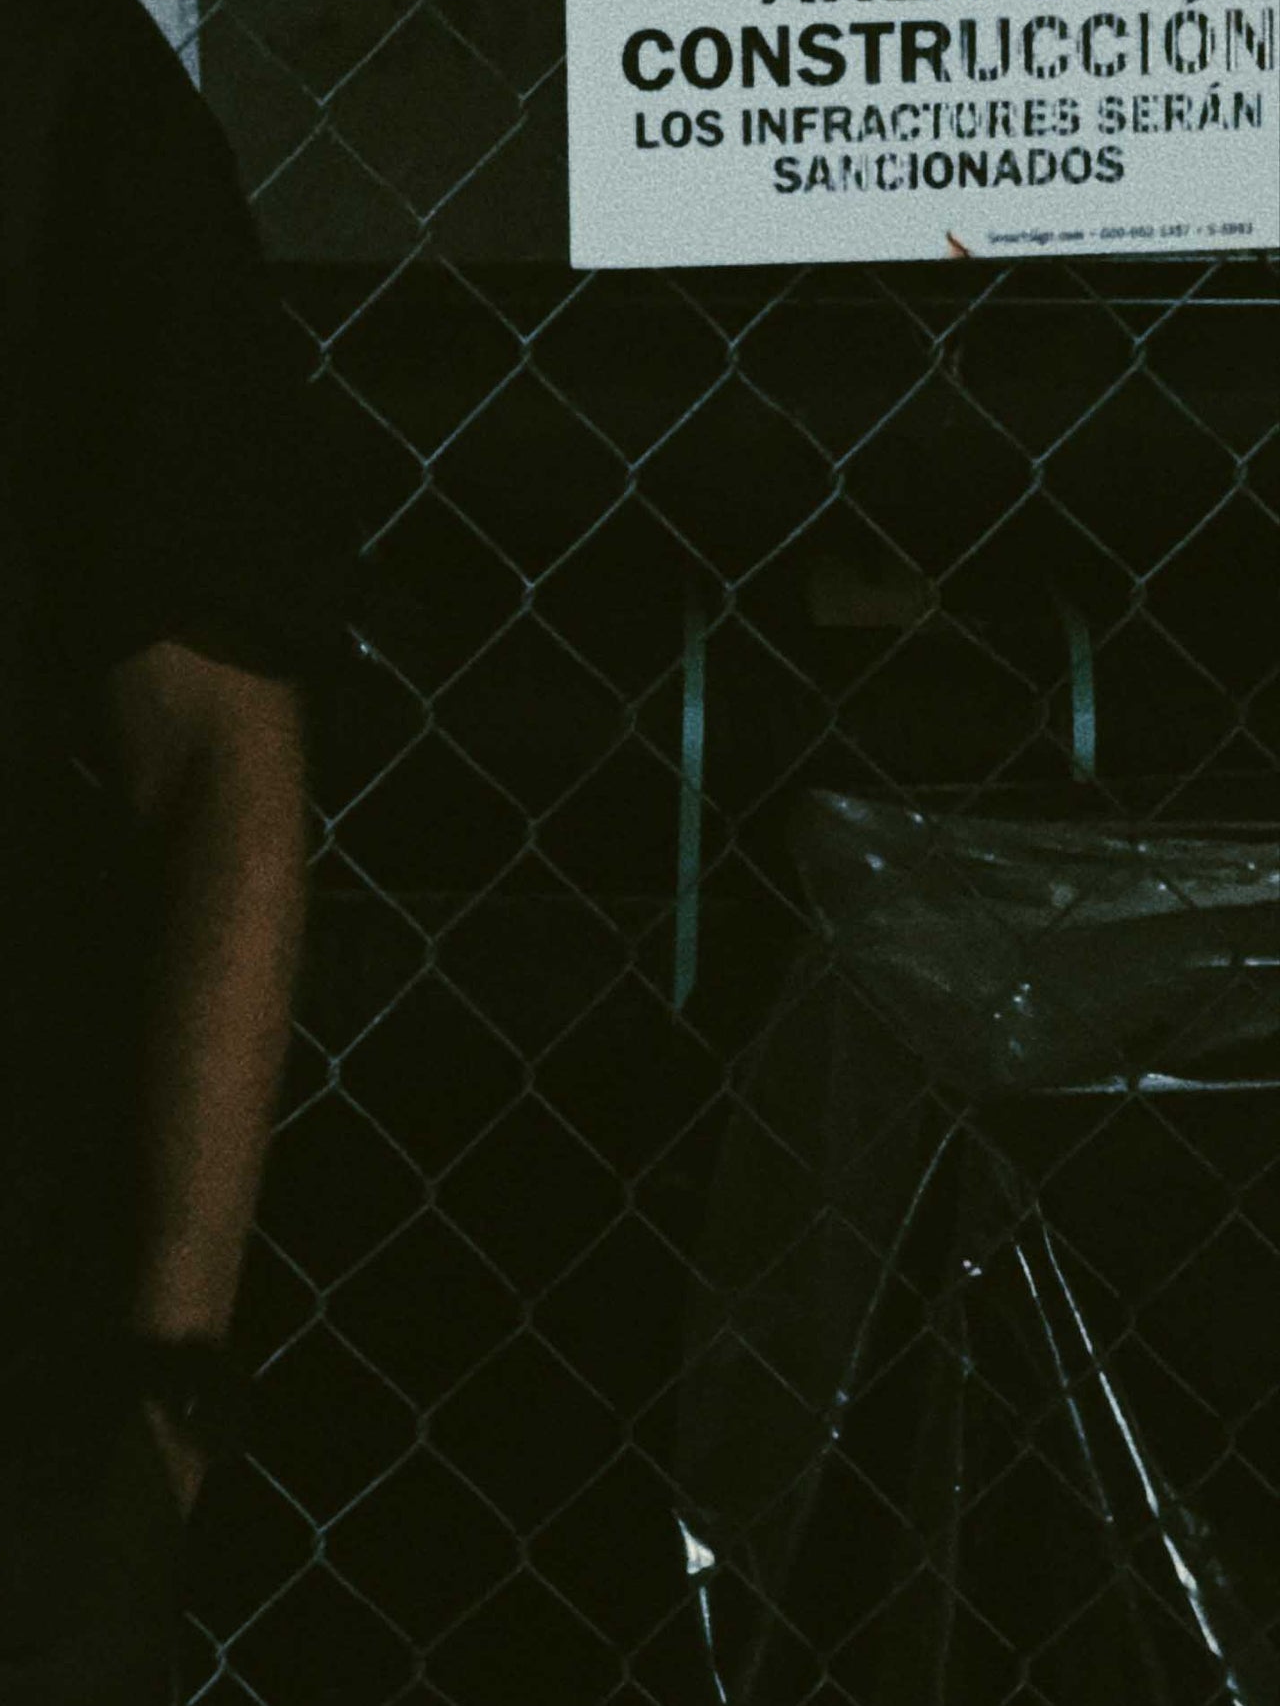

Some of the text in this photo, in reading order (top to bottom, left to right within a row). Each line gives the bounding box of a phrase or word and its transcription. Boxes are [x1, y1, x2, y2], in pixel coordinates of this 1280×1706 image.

[634, 81, 1263, 150] LOS INFRACTORES SERÁN
[773, 145, 1126, 195] SANCIONADOS
